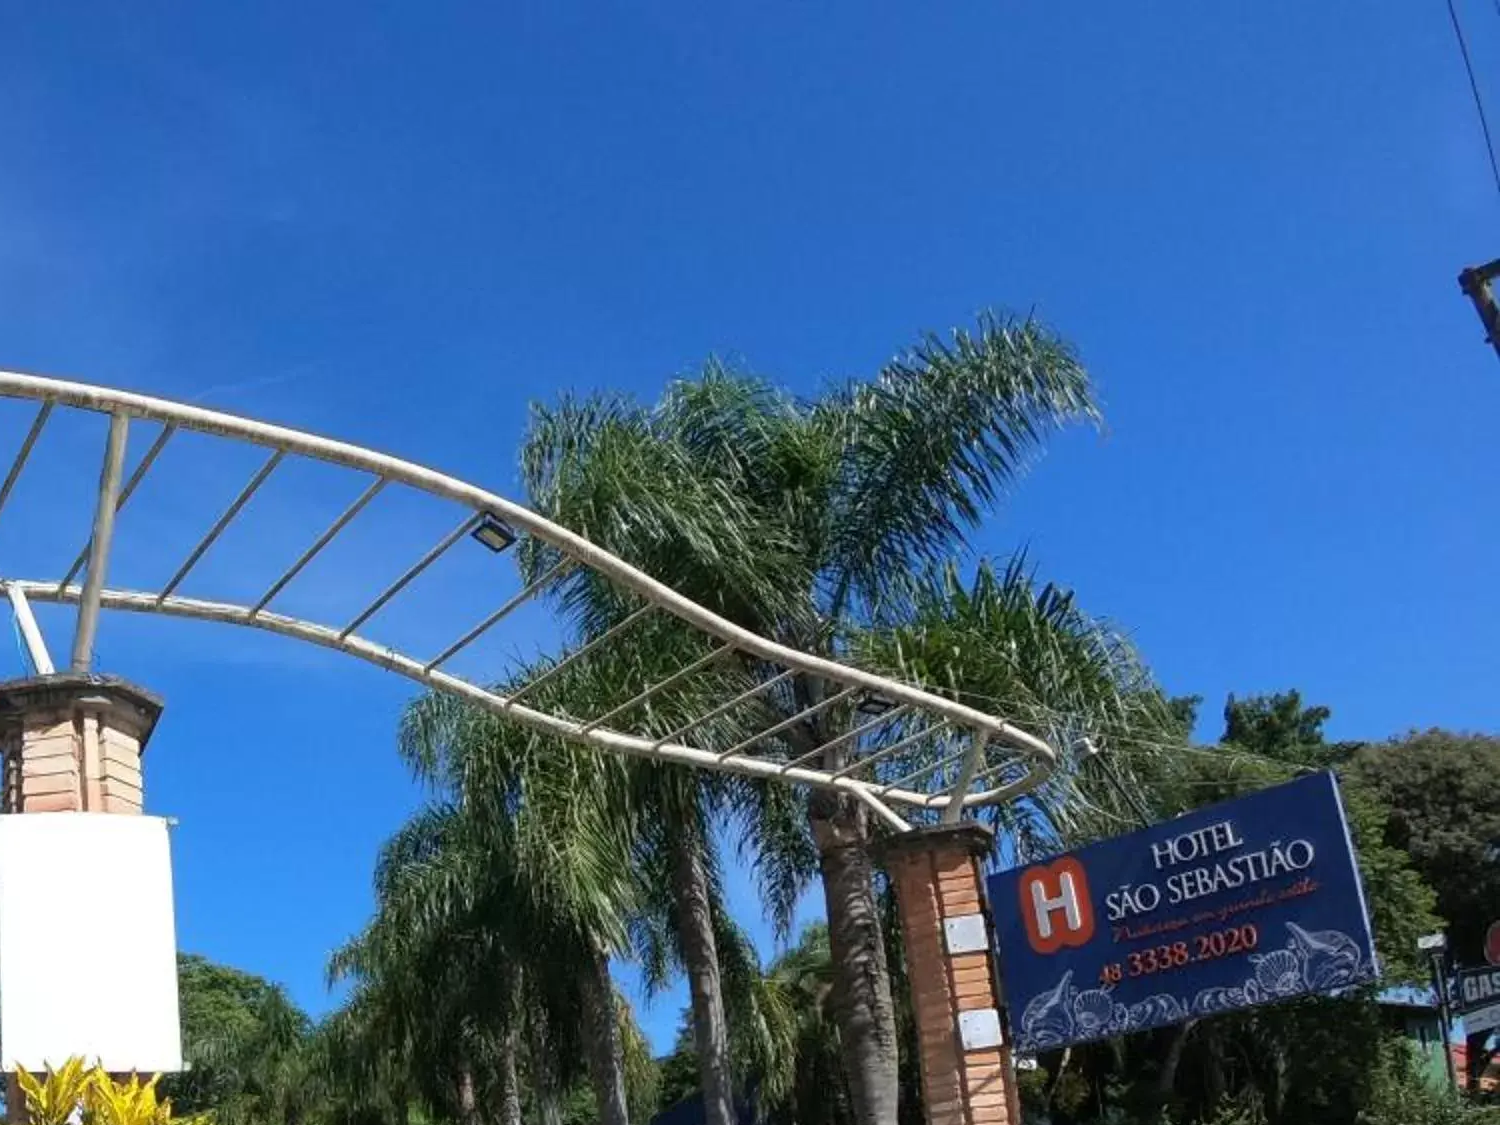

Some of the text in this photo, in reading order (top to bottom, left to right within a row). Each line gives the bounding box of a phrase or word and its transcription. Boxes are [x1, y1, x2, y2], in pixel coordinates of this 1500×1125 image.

[1151, 821, 1243, 869] HOTEL
[1031, 871, 1082, 938] H
[1105, 839, 1314, 921] SÃO SEBASTIÃO
[1099, 963, 1123, 983] 48
[1128, 924, 1257, 977] 3338.2020
